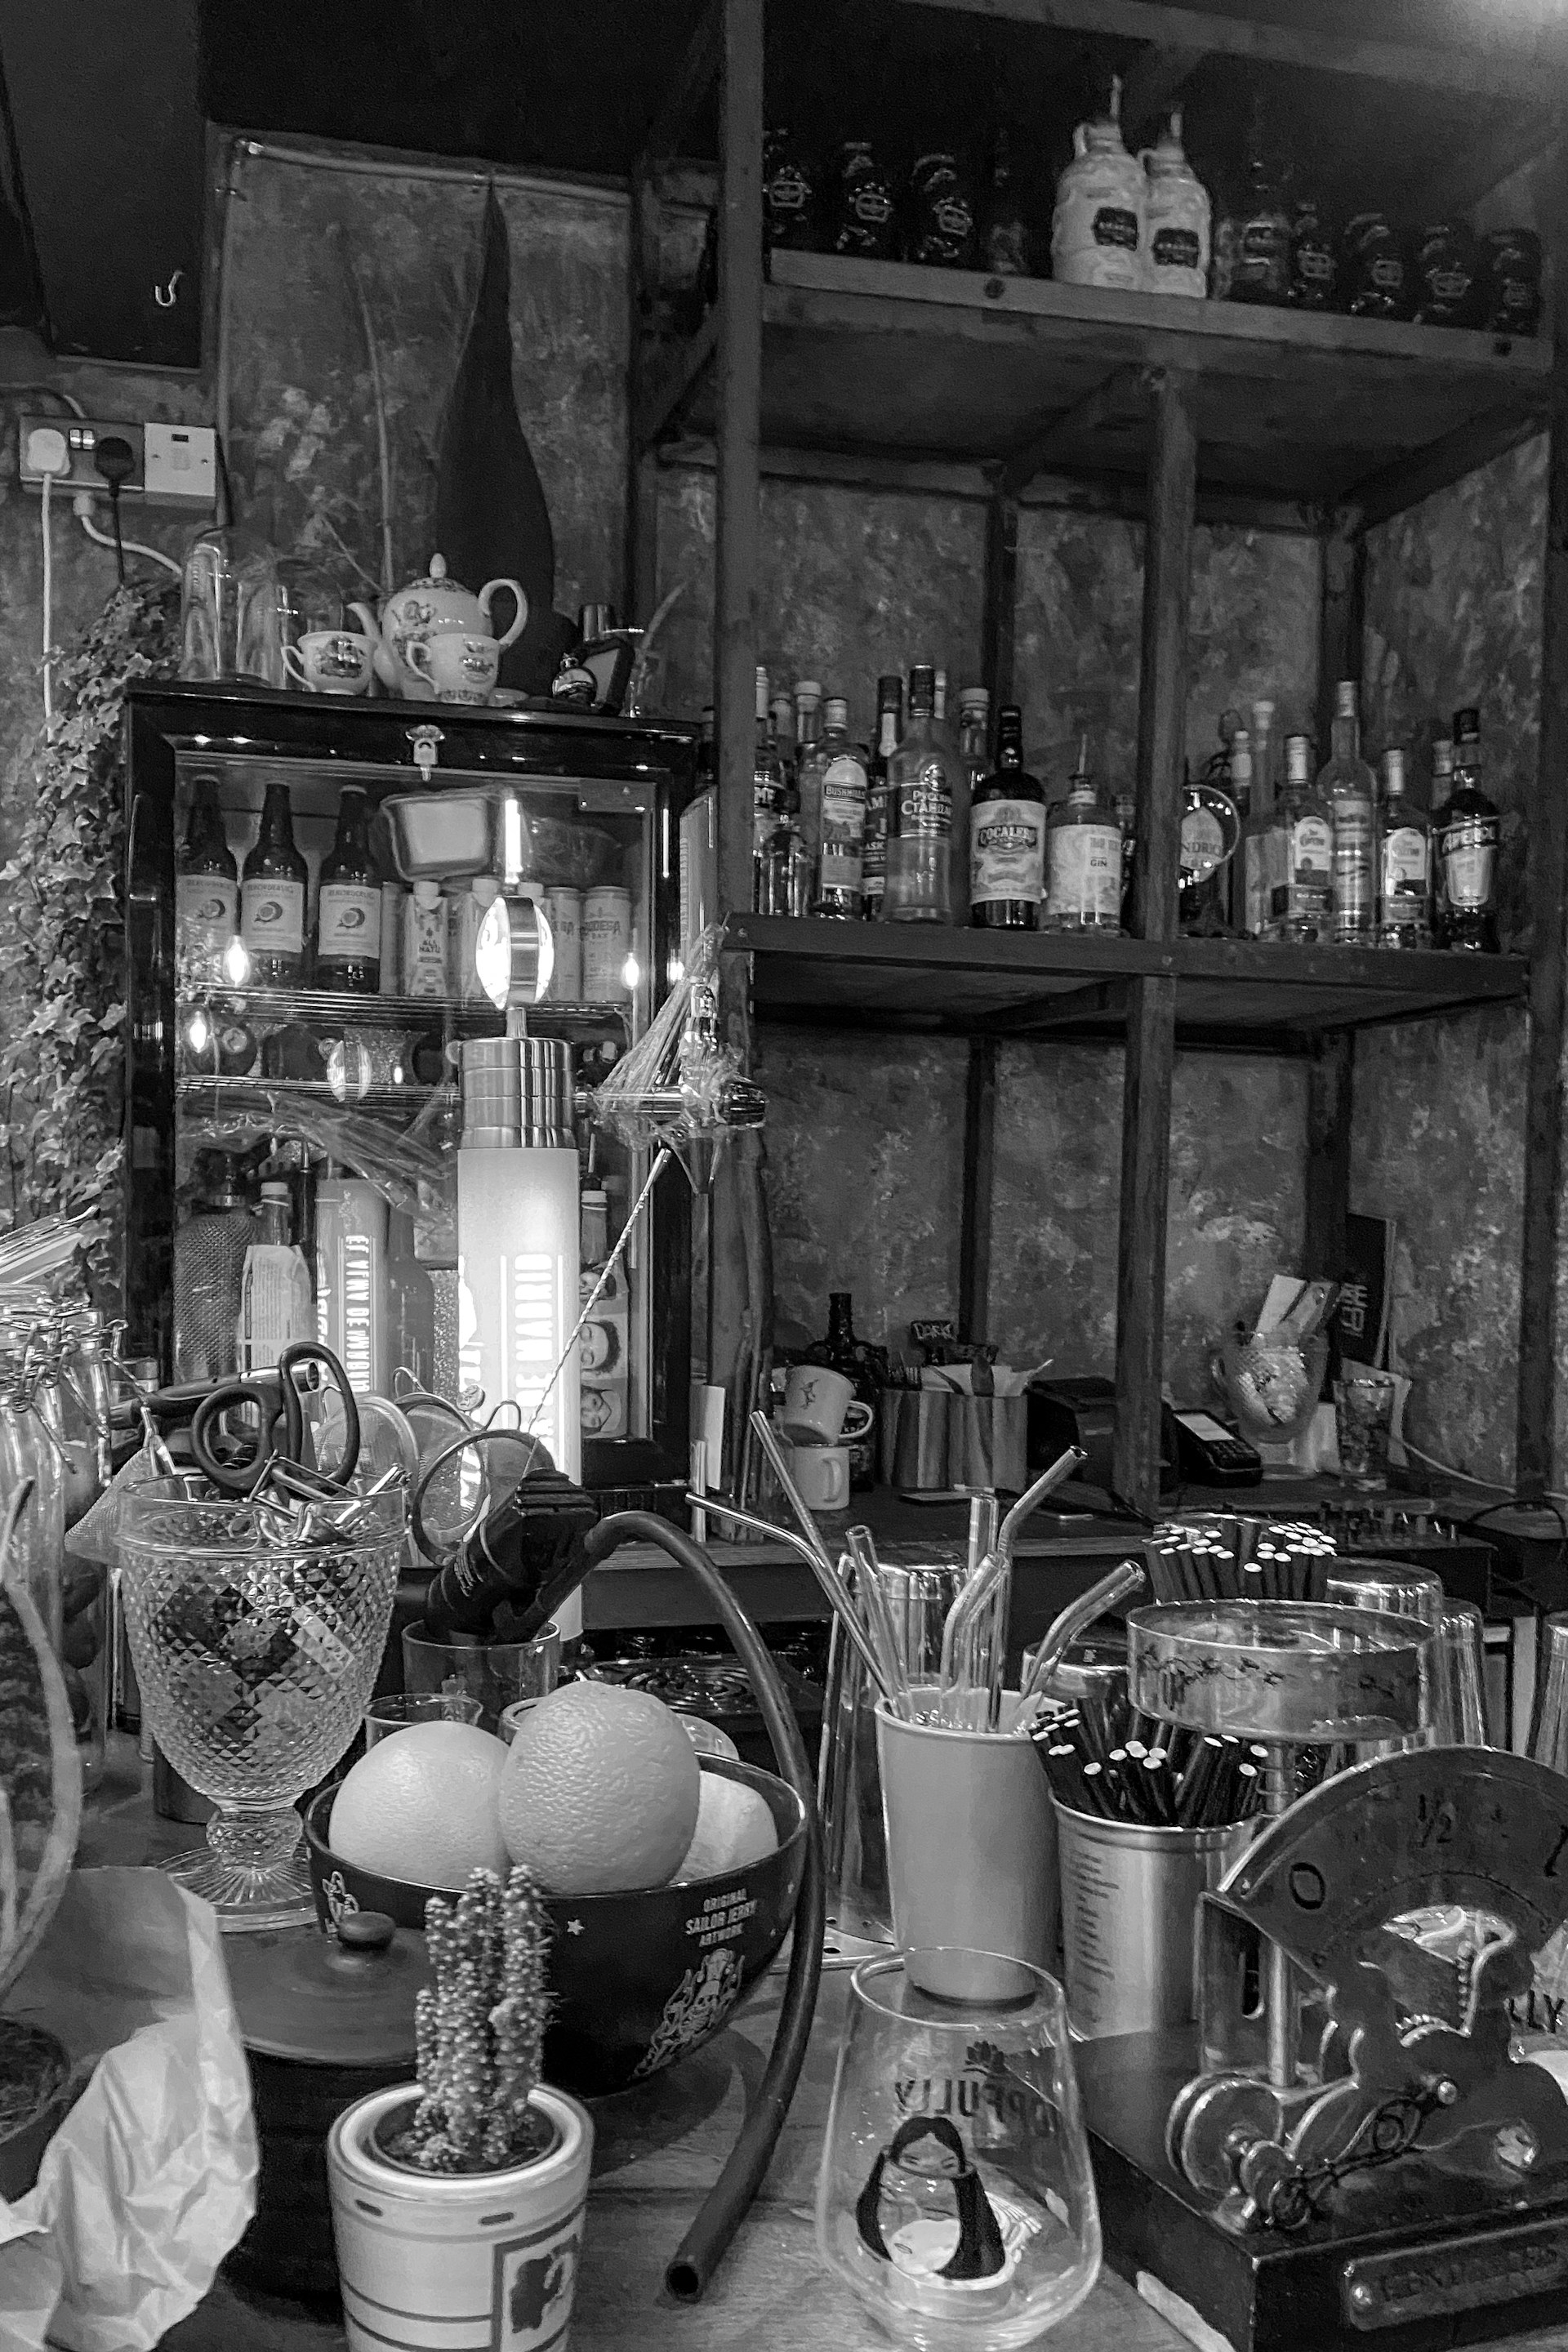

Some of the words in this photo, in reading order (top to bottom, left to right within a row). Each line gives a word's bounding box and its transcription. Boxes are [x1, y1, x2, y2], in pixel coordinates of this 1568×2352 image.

[826, 786, 866, 799] BUSHMILLS
[1090, 858, 1107, 867] GIN
[703, 1887, 748, 1913] ORIGINAL
[685, 1912, 726, 1936] SAILOR
[728, 1900, 758, 1925] JERRY
[699, 1922, 745, 1948] ARTWORK
